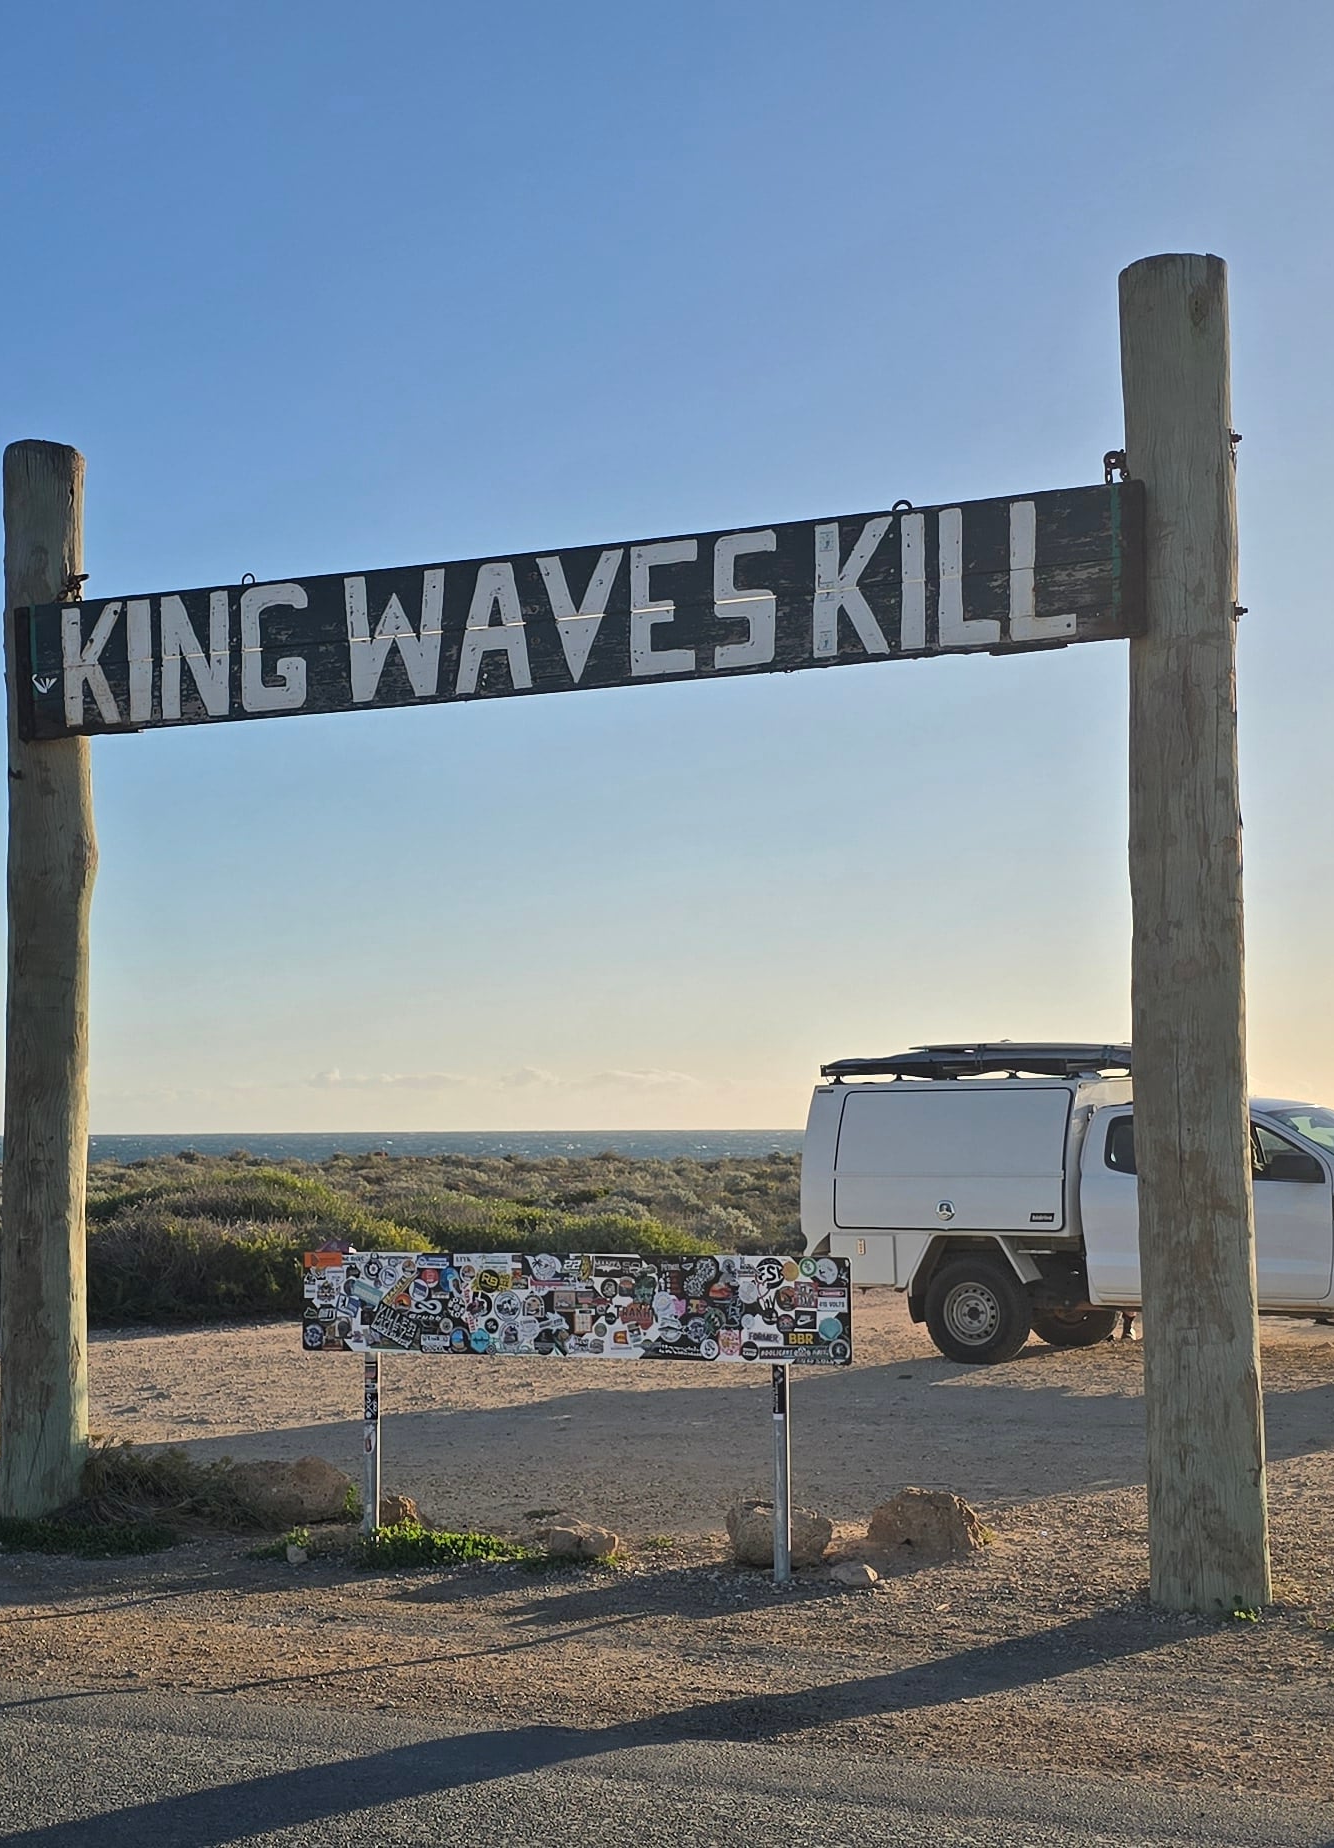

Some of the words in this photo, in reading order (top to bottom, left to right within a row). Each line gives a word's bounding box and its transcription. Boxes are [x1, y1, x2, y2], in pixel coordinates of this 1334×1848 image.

[61, 583, 308, 728] KING
[344, 529, 777, 702] WAVES
[813, 501, 1076, 658] KILL
[788, 1333, 814, 1345] BBR
